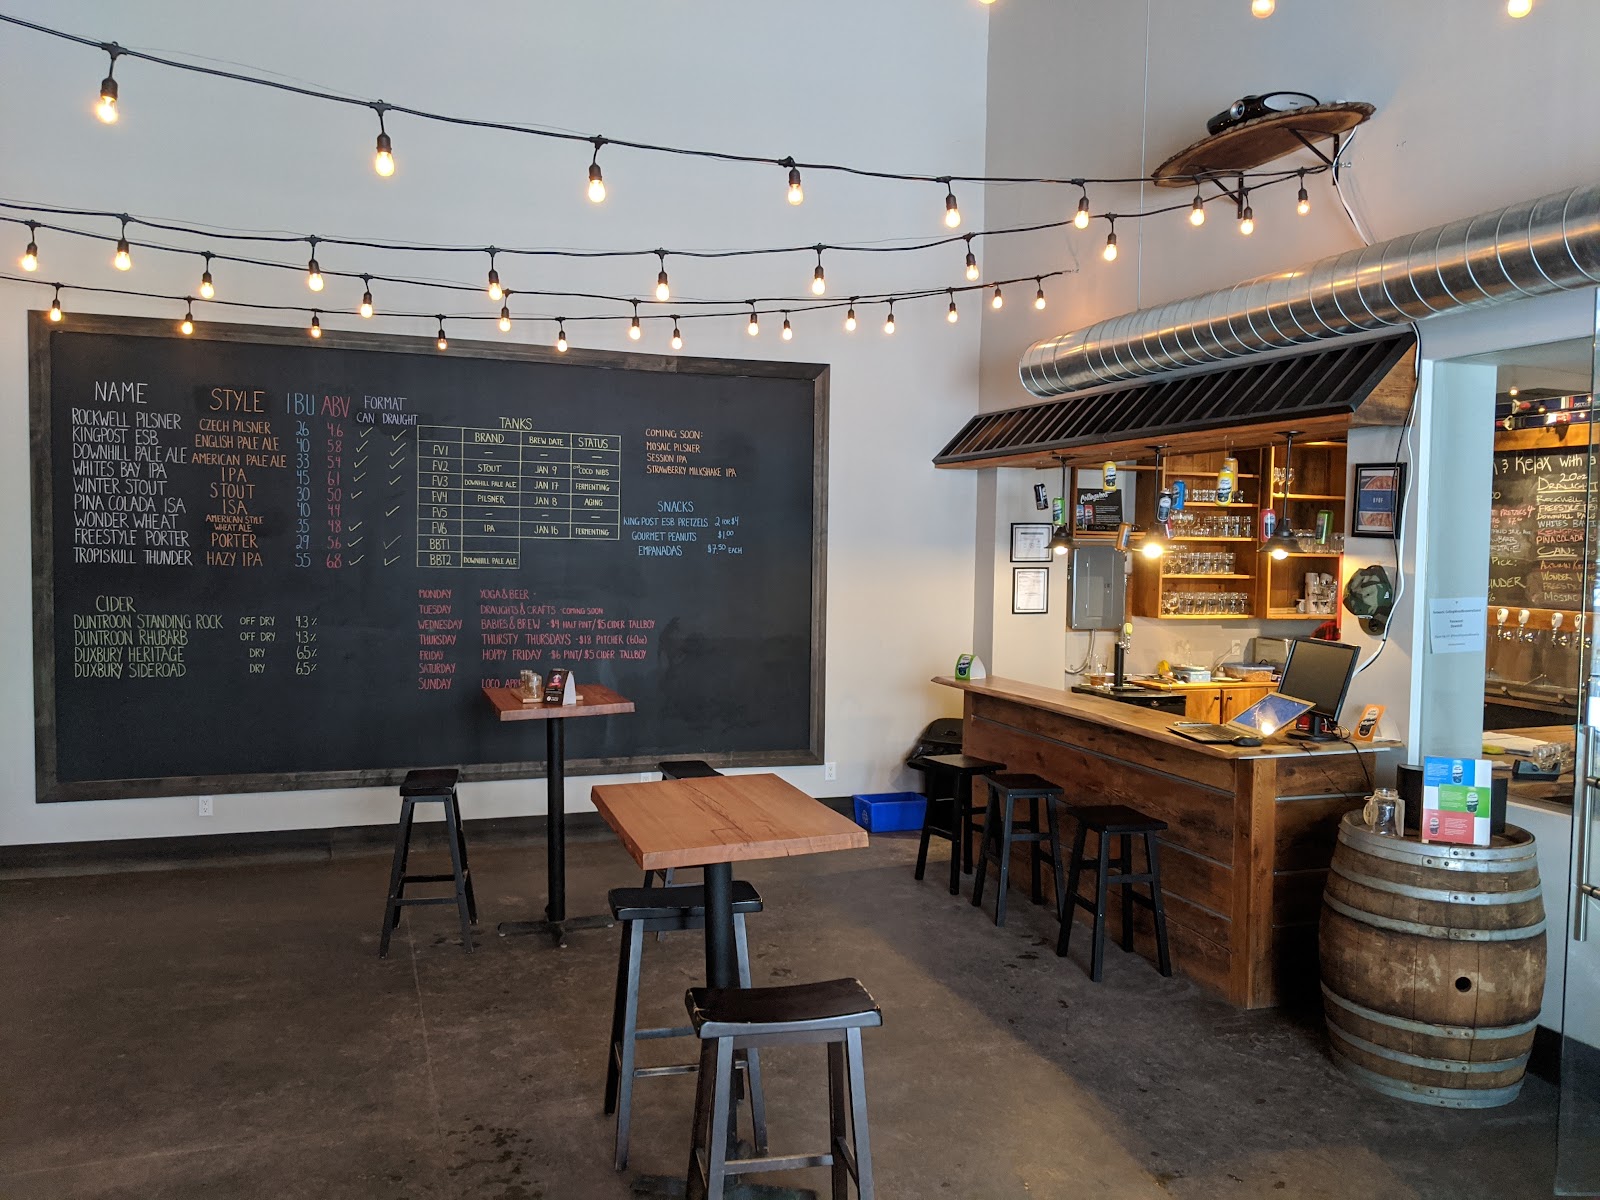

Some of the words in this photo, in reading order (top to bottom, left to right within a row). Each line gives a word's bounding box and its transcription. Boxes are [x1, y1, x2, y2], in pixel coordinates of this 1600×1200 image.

[95, 381, 148, 403] NAME
[210, 388, 265, 412] STYLE
[287, 393, 314, 415] IBU
[365, 395, 407, 411] FORMAT
[321, 396, 350, 418] ABV
[72, 408, 130, 427] ROCKWELL
[136, 412, 181, 429] PILSNER
[357, 412, 374, 424] CAN
[383, 413, 418, 425] DRAUGHT
[499, 417, 532, 430] TANKS
[200, 419, 229, 432] CZECH
[233, 420, 271, 434] PILSNER
[296, 421, 309, 436] 26
[72, 427, 128, 443] KINGPOST
[136, 430, 158, 445] ESB
[475, 432, 504, 444] BRAND
[646, 428, 677, 438] COMING
[680, 430, 703, 439] SOON:
[195, 434, 234, 448] ENGLISH
[238, 436, 258, 450] PALE
[262, 437, 279, 451] ALE
[297, 438, 310, 452] 40
[529, 436, 546, 445] BREW
[548, 437, 563, 446] DATE
[578, 438, 608, 448] STATUS
[433, 445, 448, 455] FV1
[647, 442, 671, 451] MOSAIC
[674, 443, 701, 453] PILSNER
[73, 444, 130, 461] DOWNHILL
[135, 446, 162, 462] PALE
[165, 447, 187, 463] ALE
[647, 453, 674, 462] SESSION
[677, 455, 687, 463] IPA
[192, 453, 240, 465] AMERICAN
[246, 454, 267, 467] PALE
[270, 455, 287, 468] ALE
[296, 453, 309, 468] 33
[433, 460, 449, 472] FV2
[1560, 454, 1582, 467] with
[72, 460, 114, 476] WHITES
[120, 462, 141, 478] BAY
[149, 463, 167, 479] IPA
[478, 464, 502, 472] STOUT
[535, 466, 548, 474] JAN
[552, 466, 557, 475] 9
[578, 467, 593, 475] COCO
[596, 468, 609, 476] NIBS
[647, 465, 686, 475] STRAWBERRY
[689, 467, 721, 476] MILKSHAKE
[726, 468, 737, 477] IPA
[221, 468, 247, 482] IPA
[297, 470, 310, 485] 45
[73, 477, 120, 494] WINTER
[125, 479, 168, 495] STOUT
[432, 476, 448, 487] FV3
[534, 482, 548, 490] JAN
[576, 483, 609, 491] FERMENTING
[210, 482, 256, 499] STOUT
[432, 491, 447, 503] FV4
[478, 495, 505, 504] PILSNER
[534, 497, 548, 505] JAN
[552, 497, 557, 506] 8
[584, 498, 603, 506] AGING
[74, 494, 104, 510] PINA
[109, 496, 156, 512] COLADA
[164, 498, 186, 514] ISA
[222, 499, 248, 514] ISA
[658, 501, 694, 512] SNACKS
[432, 507, 447, 518] FV5
[74, 512, 130, 529] WONDER
[133, 514, 179, 530] WHEAT
[206, 515, 243, 524] AMERICAN
[245, 515, 264, 524] STYLE
[662, 518, 675, 526] ESB
[678, 519, 708, 527] PRETZELS
[214, 524, 237, 532] WHEAT
[238, 524, 252, 532] ALE
[432, 522, 447, 534] FV6
[484, 524, 495, 533] IPA
[534, 526, 548, 534] JAN
[551, 526, 558, 534] 16
[576, 528, 609, 536] FERMENTING
[75, 529, 137, 545] FREESTYLE
[146, 530, 190, 547] PORTER
[212, 534, 258, 548] PORTER
[632, 531, 666, 540] GOURMET
[668, 532, 696, 541] PEANUTS
[429, 538, 450, 550] BBT1
[639, 545, 682, 556] EMPANADAS
[73, 547, 136, 564] TROPISKULL
[143, 549, 193, 566] THUNDER
[207, 552, 236, 566] HAZY
[242, 553, 263, 566] IPA
[295, 553, 310, 567] 55
[430, 554, 452, 565] BBT2
[419, 589, 452, 598] MONDAY
[96, 595, 136, 612] CIDER
[480, 604, 518, 614] DRAUGHTS
[527, 605, 556, 614] CRAFTS
[420, 605, 452, 614] TUESDAY
[74, 614, 132, 629] DUNTROON
[137, 614, 191, 629] STANDING
[196, 614, 223, 629] ROCK
[240, 616, 255, 626] OFF
[260, 616, 275, 626] DRY
[418, 620, 462, 630] WEDNESDAY
[481, 619, 508, 630] BABIES
[517, 619, 540, 630] BREW
[629, 620, 655, 629] TALLBOY
[75, 630, 133, 645] DUNTROON
[139, 630, 188, 645] RHUBARB
[240, 632, 255, 641] OFF
[261, 632, 276, 642] DRY
[420, 634, 456, 645] THURSDAY
[481, 634, 518, 645] THURSTY
[524, 634, 571, 645] THURSDAYS
[596, 635, 624, 644] PITCHER
[75, 646, 123, 663] DUXBURY
[129, 646, 184, 662] HERITAGE
[250, 648, 265, 658] DRY
[420, 651, 444, 660] FRIDAY
[482, 649, 507, 660] HOPPY
[513, 649, 542, 660] FRIDAY
[596, 650, 615, 659] CIDER
[620, 650, 646, 659] TALLBOY
[74, 663, 123, 679] DUXBURY
[129, 663, 186, 678] SIDEROAD
[250, 664, 265, 673] DRY
[419, 663, 456, 673] SATURDAY
[418, 678, 451, 689] SUNDAY
